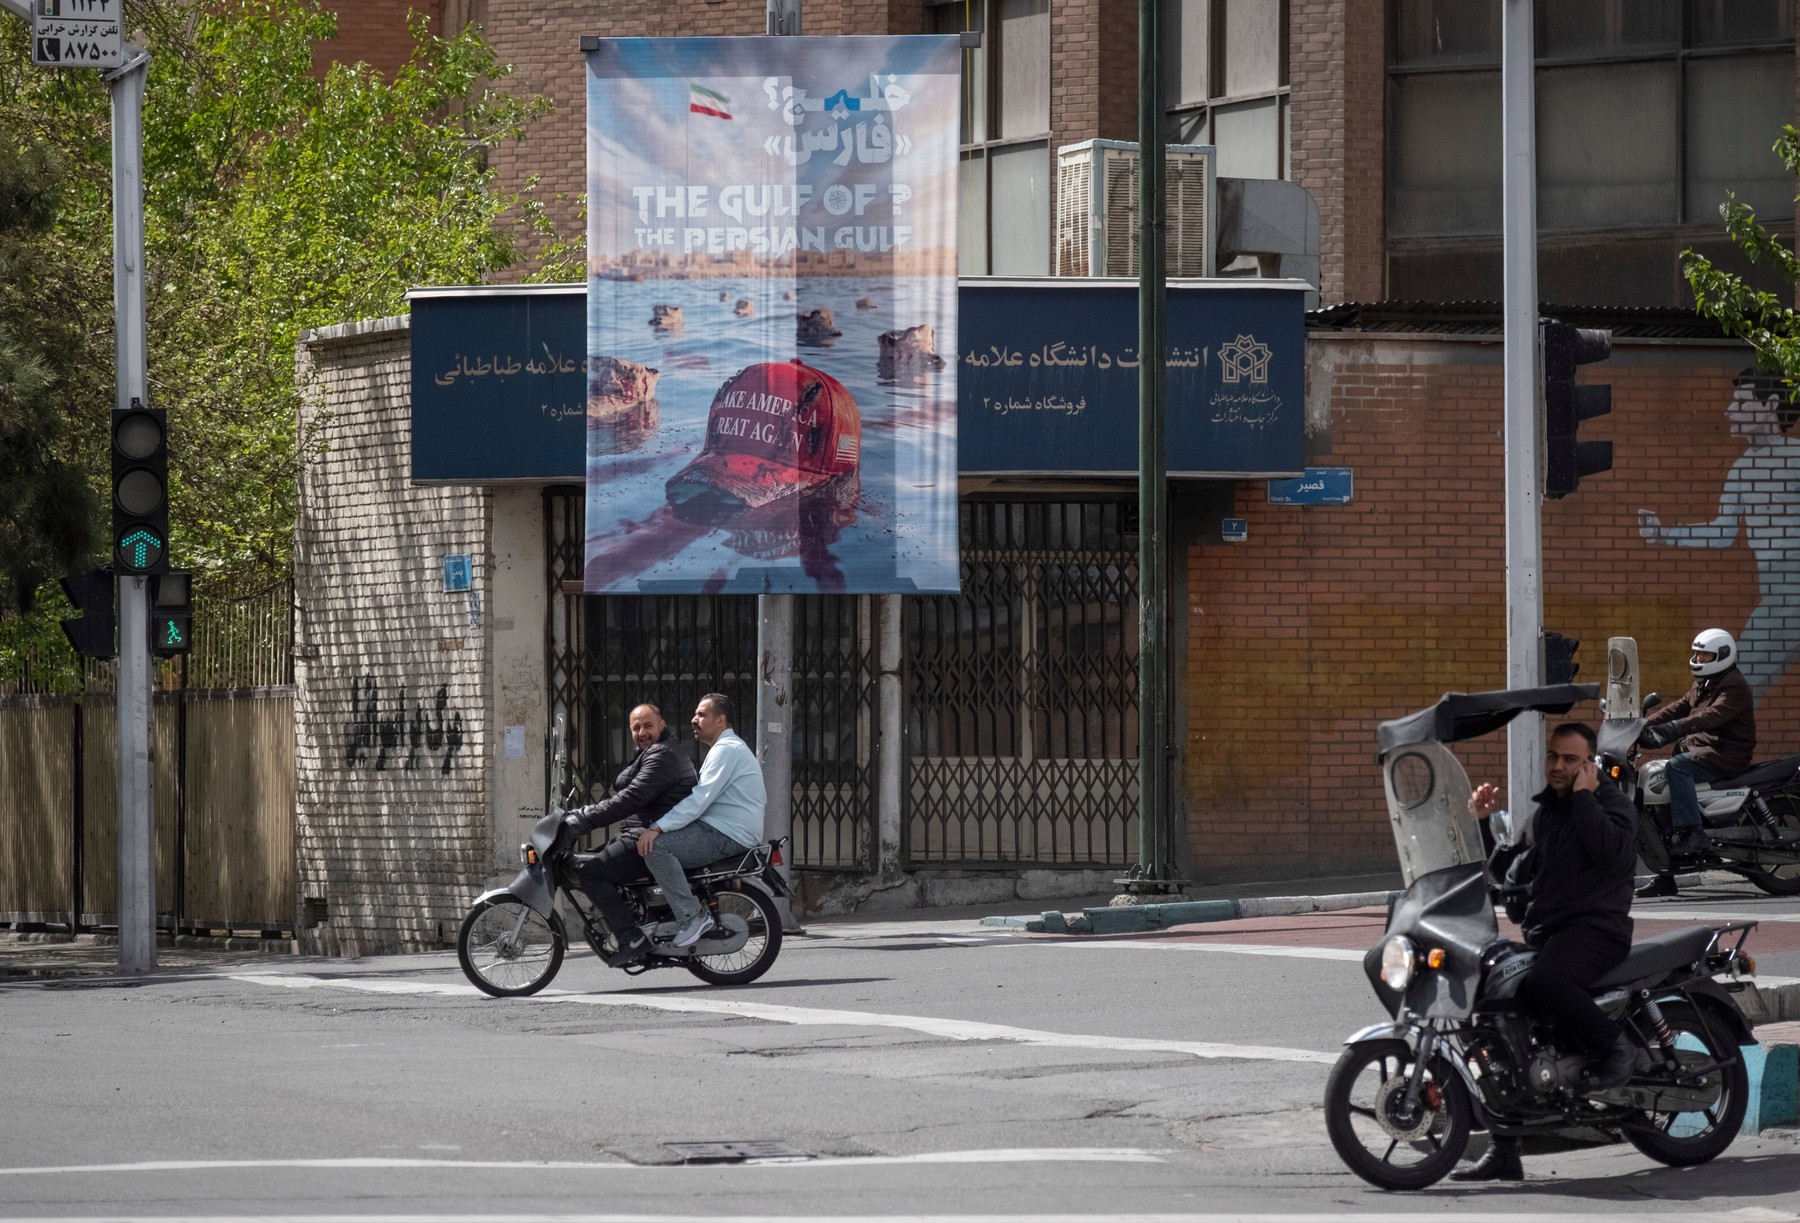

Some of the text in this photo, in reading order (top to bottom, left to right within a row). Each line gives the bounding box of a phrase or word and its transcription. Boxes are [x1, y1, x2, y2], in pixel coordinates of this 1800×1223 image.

[38, 23, 119, 37] تلفن گزارش خرابی
[64, 41, 118, 60] ۸۷۵۰۰
[632, 183, 912, 225] THE GULF OF ?
[635, 226, 912, 259] THE PERSIAN GULF
[525, 341, 576, 375] علامه
[964, 345, 1024, 367] علامه
[1029, 340, 1112, 369] دانشگاه
[713, 390, 747, 411] AKE
[994, 396, 1032, 415] شماره
[1035, 395, 1086, 415] فروشگاه
[550, 402, 583, 422] شماره
[713, 416, 751, 437] REAT
[1297, 479, 1325, 493] قصیر
